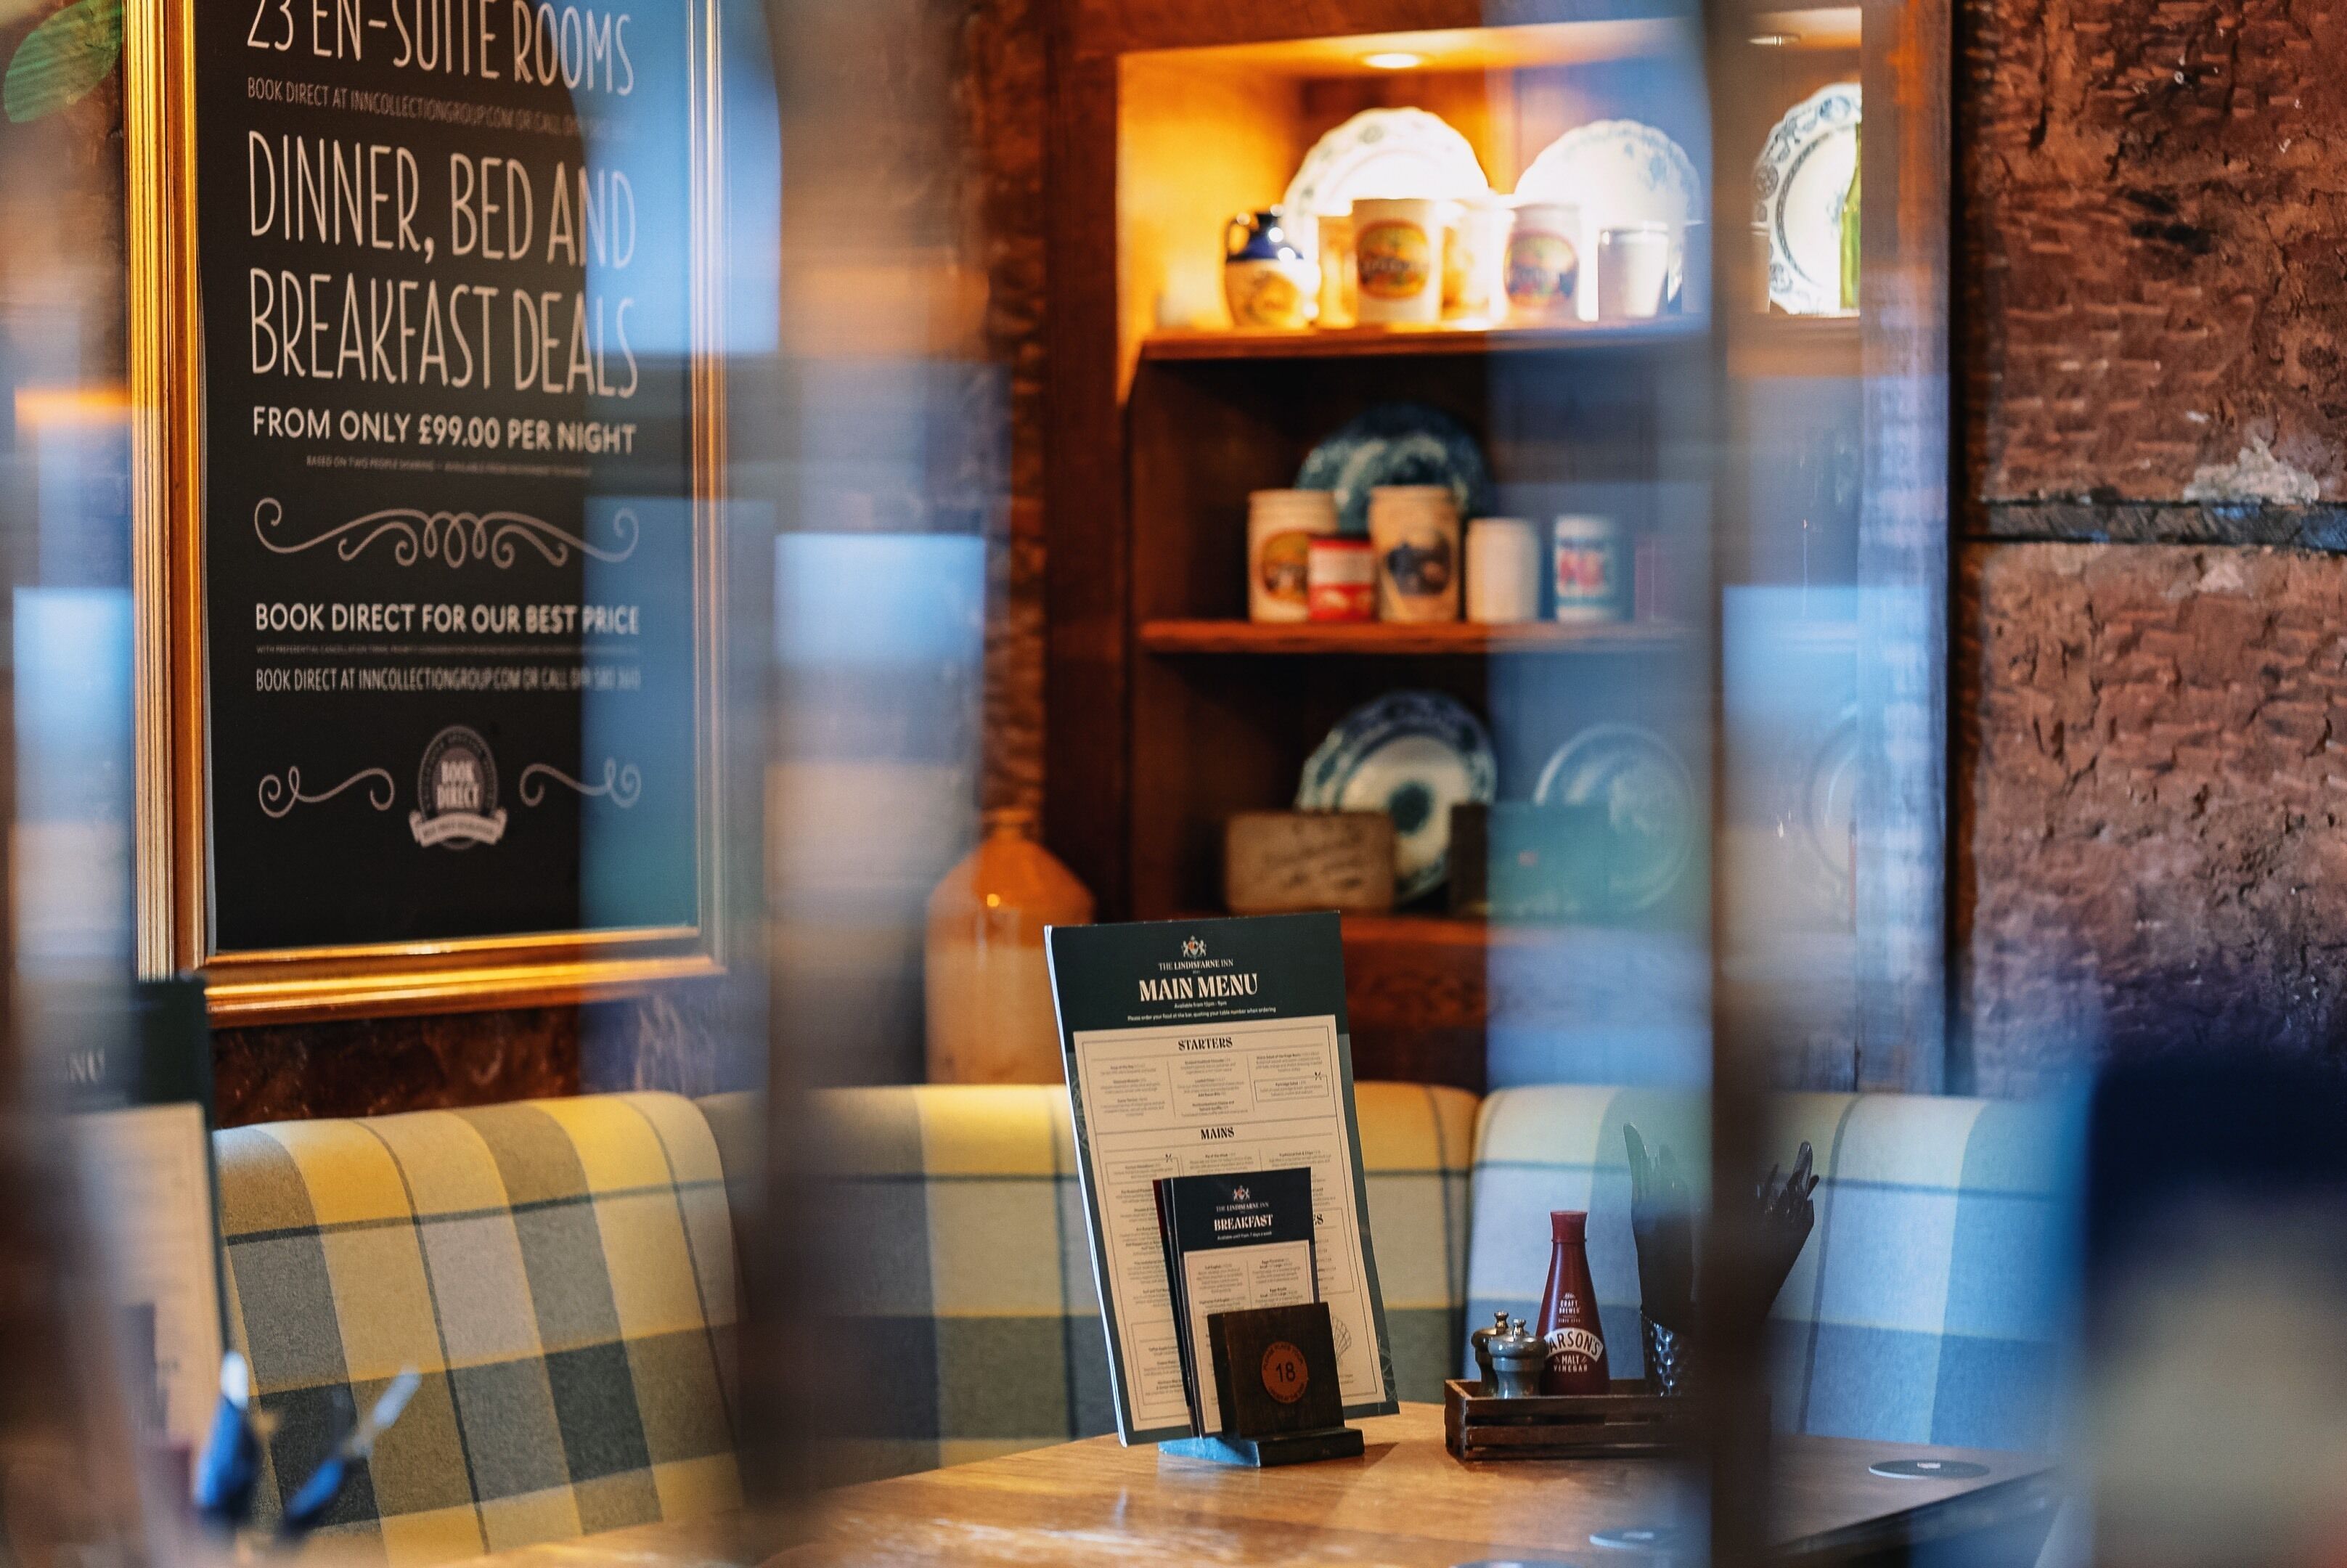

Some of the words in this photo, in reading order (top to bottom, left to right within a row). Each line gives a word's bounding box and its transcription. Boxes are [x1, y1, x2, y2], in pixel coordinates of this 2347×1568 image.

[313, 0, 500, 78] EN-SUITE
[513, 0, 635, 96] ROOMS
[248, 76, 283, 102] BOOK
[286, 81, 329, 107] DIRECT
[332, 86, 348, 109] AT
[249, 131, 434, 264] DINNER,
[451, 152, 533, 260] BED
[547, 161, 636, 269] AND
[250, 267, 499, 390] BREAKFAST
[514, 289, 638, 399] DEALS
[253, 406, 330, 439] FROM
[340, 409, 412, 444] ONLY
[418, 413, 501, 449] £99.00
[508, 417, 552, 451] PER
[557, 421, 637, 454] NIGHT
[256, 603, 325, 632] BOOK
[332, 603, 415, 633] DIRECT
[422, 604, 467, 634] FOR
[471, 604, 521, 634] OUR
[525, 605, 579, 635] BEST
[582, 605, 640, 635] PRICE
[256, 667, 291, 692] BOOK
[294, 667, 338, 692] DIRECT
[340, 667, 356, 690] AT
[1159, 962, 1173, 971] THE
[1174, 959, 1220, 971] LINDISFARNE
[1221, 957, 1234, 967] INN
[1139, 976, 1193, 1002] MAIN
[1198, 973, 1257, 998] MENU
[1178, 1037, 1233, 1051] STARTERS
[1201, 1127, 1235, 1140] MAINS
[1214, 1214, 1273, 1232] BREAKFAST
[1548, 1331, 1600, 1356] ARSON'S
[1275, 1361, 1296, 1383] 18
[1562, 1355, 1579, 1364] MALT
